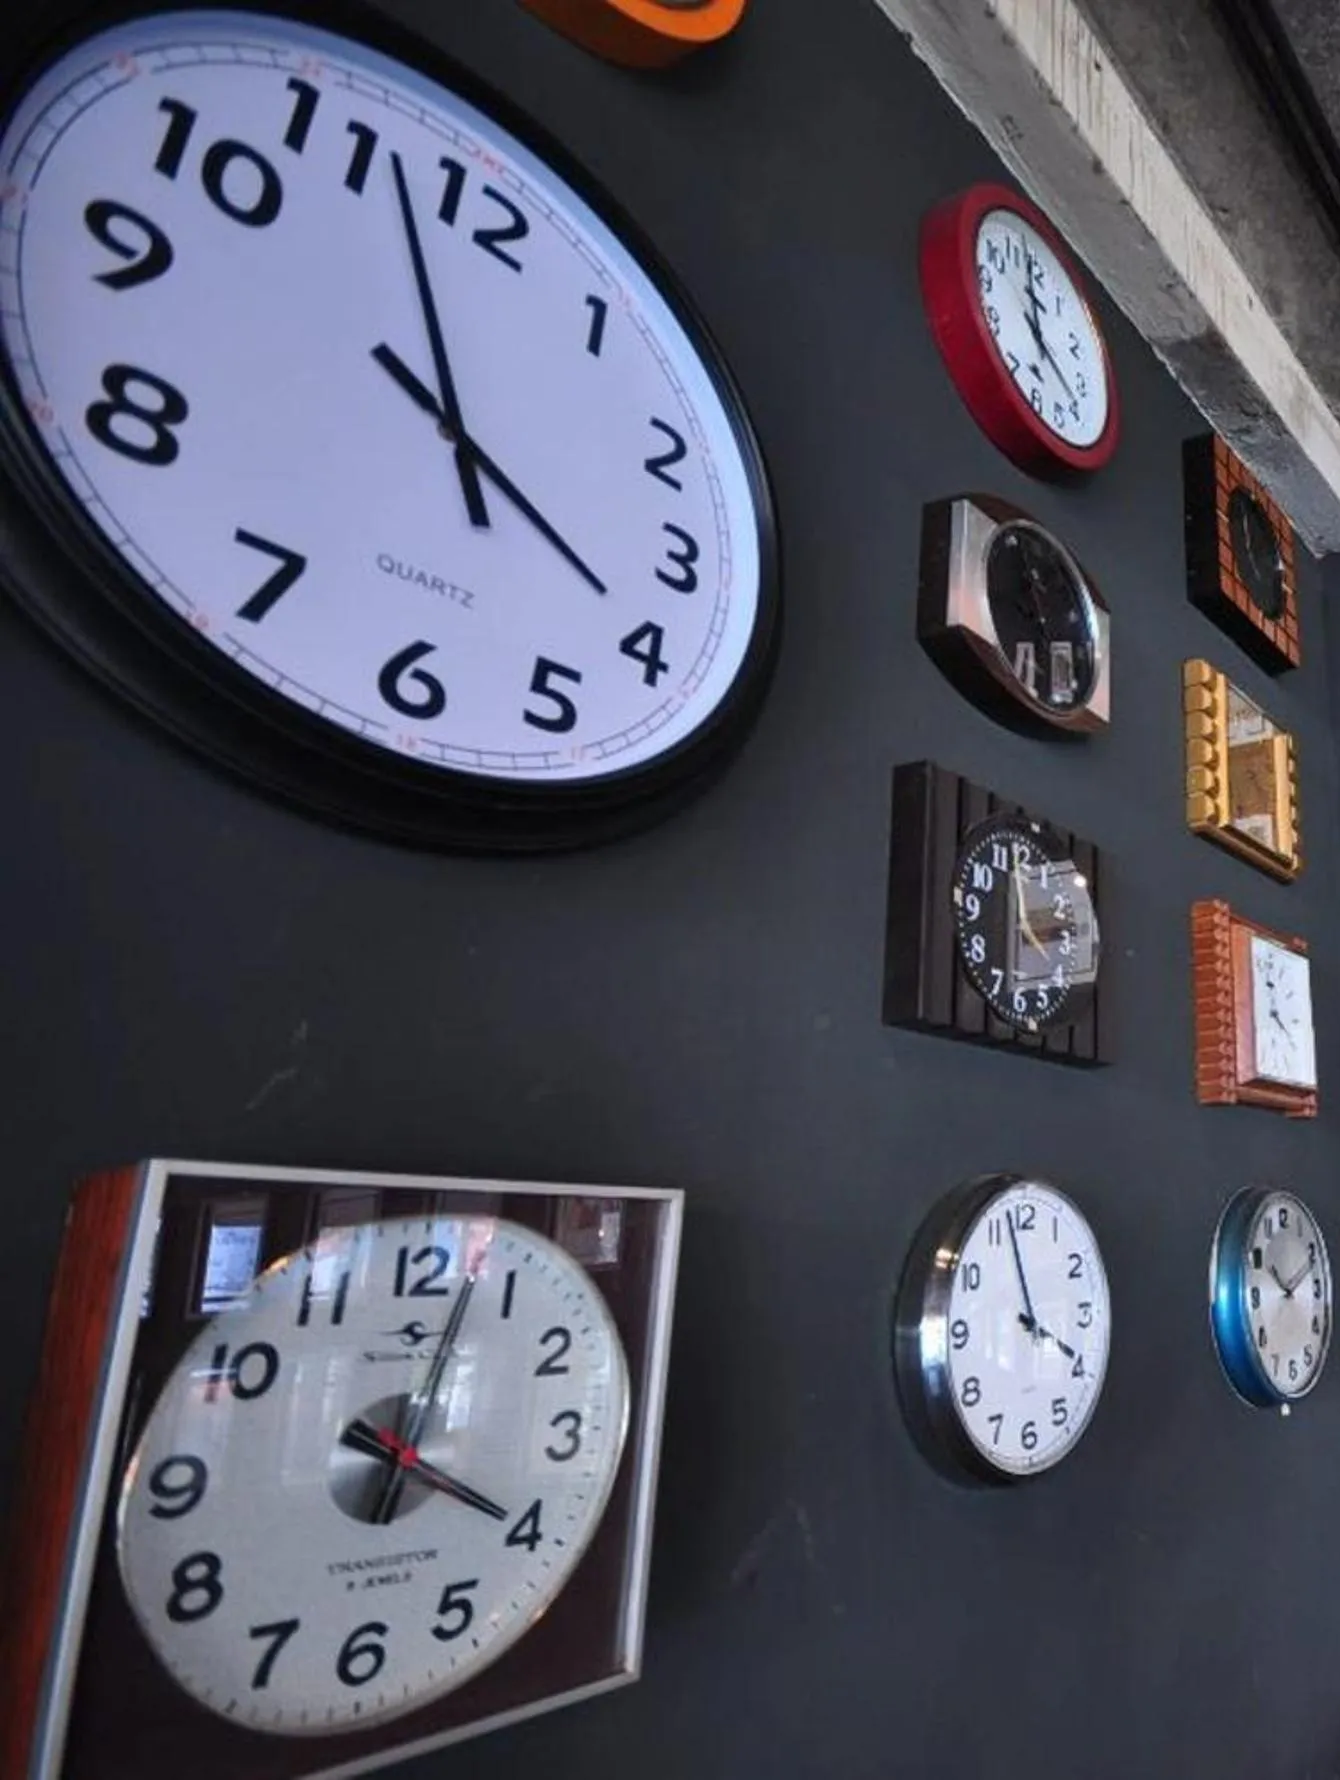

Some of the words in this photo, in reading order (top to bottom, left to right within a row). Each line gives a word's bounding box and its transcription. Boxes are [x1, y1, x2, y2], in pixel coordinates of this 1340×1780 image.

[283, 76, 379, 197] 11
[154, 96, 283, 229] 10
[437, 156, 530, 274] 12
[84, 198, 174, 292] 9
[584, 294, 608, 357] 1
[1068, 331, 1081, 360] 2
[85, 363, 189, 467] 8
[644, 417, 687, 492] 2
[654, 522, 699, 594] 3
[234, 527, 307, 623] 7
[376, 553, 476, 610] QUARTZ
[618, 620, 669, 687] 4
[377, 640, 446, 720] 6
[523, 655, 583, 734] 5
[992, 843, 1008, 872] 11
[1011, 842, 1032, 872] 12
[973, 862, 993, 892] 10
[1040, 864, 1048, 890] 1
[965, 894, 980, 921] 9
[1053, 894, 1067, 921] 2
[971, 933, 986, 963] 8
[1059, 929, 1071, 956] 3
[991, 966, 1005, 995] 7
[1051, 963, 1064, 988] 4
[1013, 986, 1027, 1012] 6
[1036, 983, 1048, 1010] 5
[989, 1218, 1001, 1246] 11
[1016, 1204, 1036, 1231] 12
[1053, 1215, 1058, 1244] 1
[392, 1246, 451, 1298] 12
[962, 1262, 981, 1292] 10
[1067, 1252, 1082, 1279] 2
[296, 1271, 350, 1327] 11
[499, 1270, 517, 1320] 1
[1077, 1301, 1093, 1329] 3
[951, 1318, 969, 1350] 9
[534, 1326, 574, 1377] 2
[1071, 1353, 1086, 1378] 4
[1271, 1353, 1280, 1377] 7
[1303, 1344, 1313, 1367] 5
[204, 1341, 281, 1403] 10
[1288, 1358, 1298, 1381] 6
[961, 1375, 981, 1407] 8
[1051, 1396, 1068, 1426] 5
[544, 1410, 583, 1462] 3
[987, 1413, 1004, 1445] 7
[1020, 1420, 1037, 1450] 6
[148, 1454, 208, 1520] 9
[504, 1499, 543, 1553] 4
[165, 1551, 225, 1624] 8
[431, 1579, 480, 1643] 5
[248, 1619, 301, 1690] 7
[335, 1621, 390, 1687] 6
